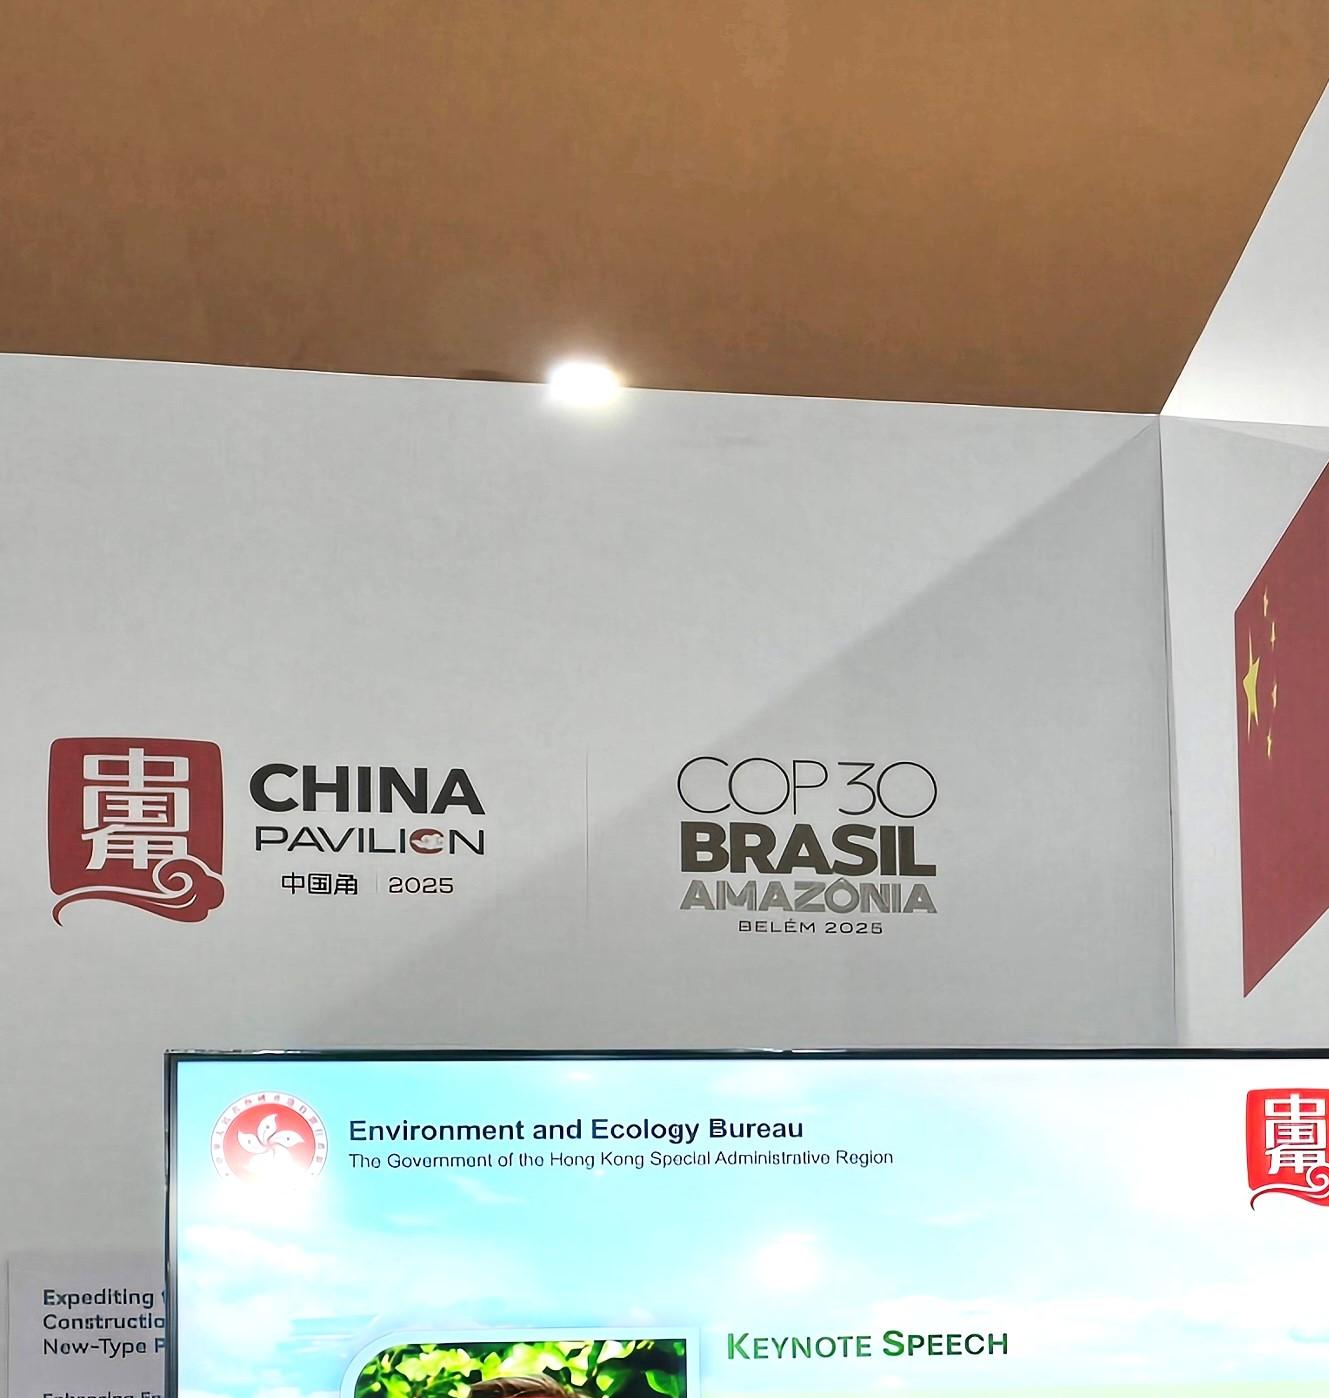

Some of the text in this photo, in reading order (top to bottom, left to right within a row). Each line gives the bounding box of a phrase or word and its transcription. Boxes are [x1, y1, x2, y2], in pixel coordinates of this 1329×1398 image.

[248, 762, 486, 816] CHINA
[83, 747, 191, 870] 中国角
[255, 827, 486, 856] PAVILION
[680, 822, 937, 877] BRASIL
[280, 872, 455, 897] 中国角 2025
[680, 877, 938, 914] AMAZÔNIA
[738, 919, 884, 935] BELÉM 2025
[348, 1116, 805, 1148] Environment and Ecology Bureau
[348, 1148, 894, 1173] The Government of the Hong Kong Special Administrative Region
[44, 1289, 154, 1309] Expediting
[44, 1339, 146, 1358] New-Type
[727, 1330, 1009, 1360] KEYNOTE SPEECH
